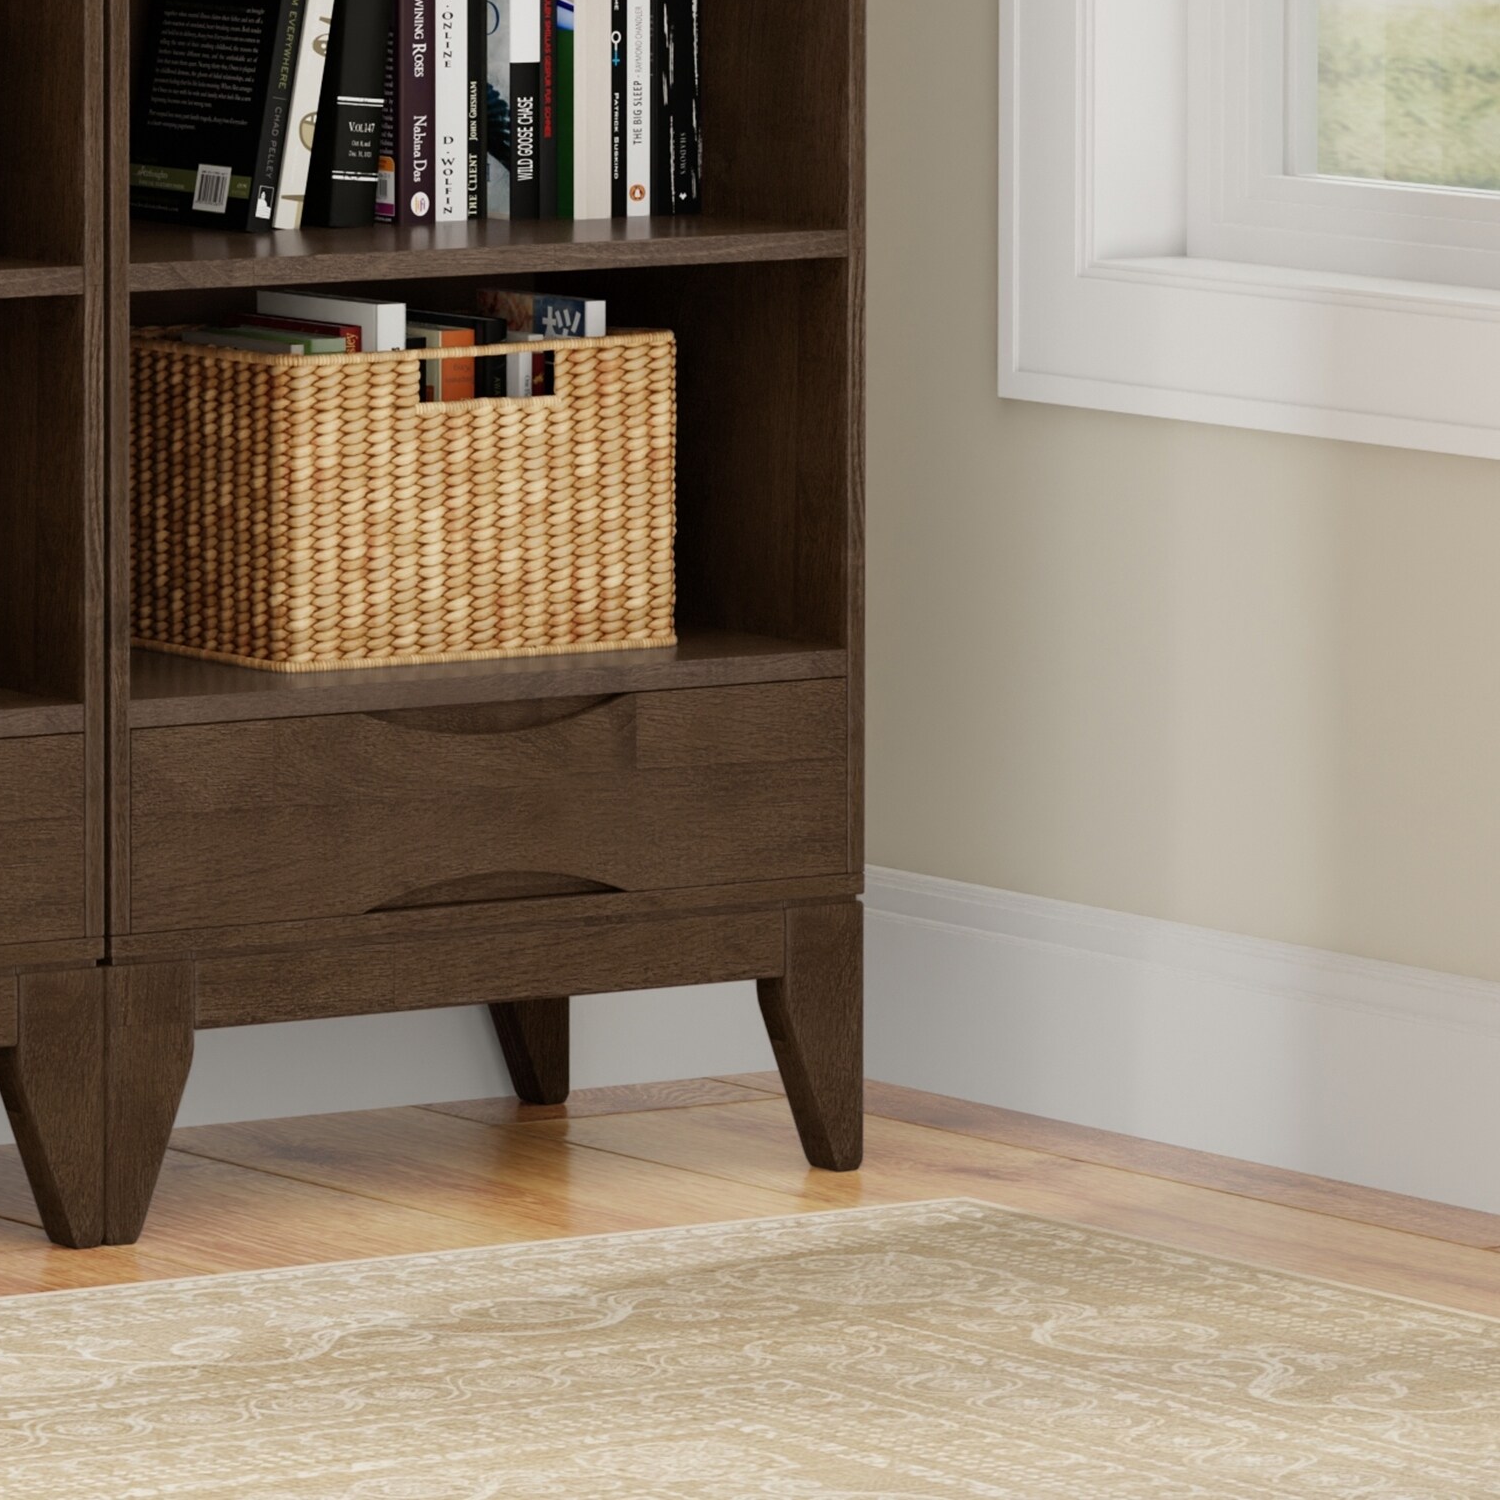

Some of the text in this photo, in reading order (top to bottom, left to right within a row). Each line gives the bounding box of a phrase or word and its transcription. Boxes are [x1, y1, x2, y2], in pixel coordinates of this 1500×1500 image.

[278, 10, 298, 90] EVERYWHERE
[412, 42, 427, 78] ROSES
[634, 6, 643, 73] RAYMOND CHANDLER
[265, 105, 283, 179] CHAD PELLEY
[469, 80, 478, 141] JOHN GRISHAM
[517, 97, 534, 182] WILD GOOSE CHASE
[633, 80, 643, 145] THE BIG SLEEP
[412, 159, 428, 183] Das
[467, 153, 478, 215] THE CLIENT
